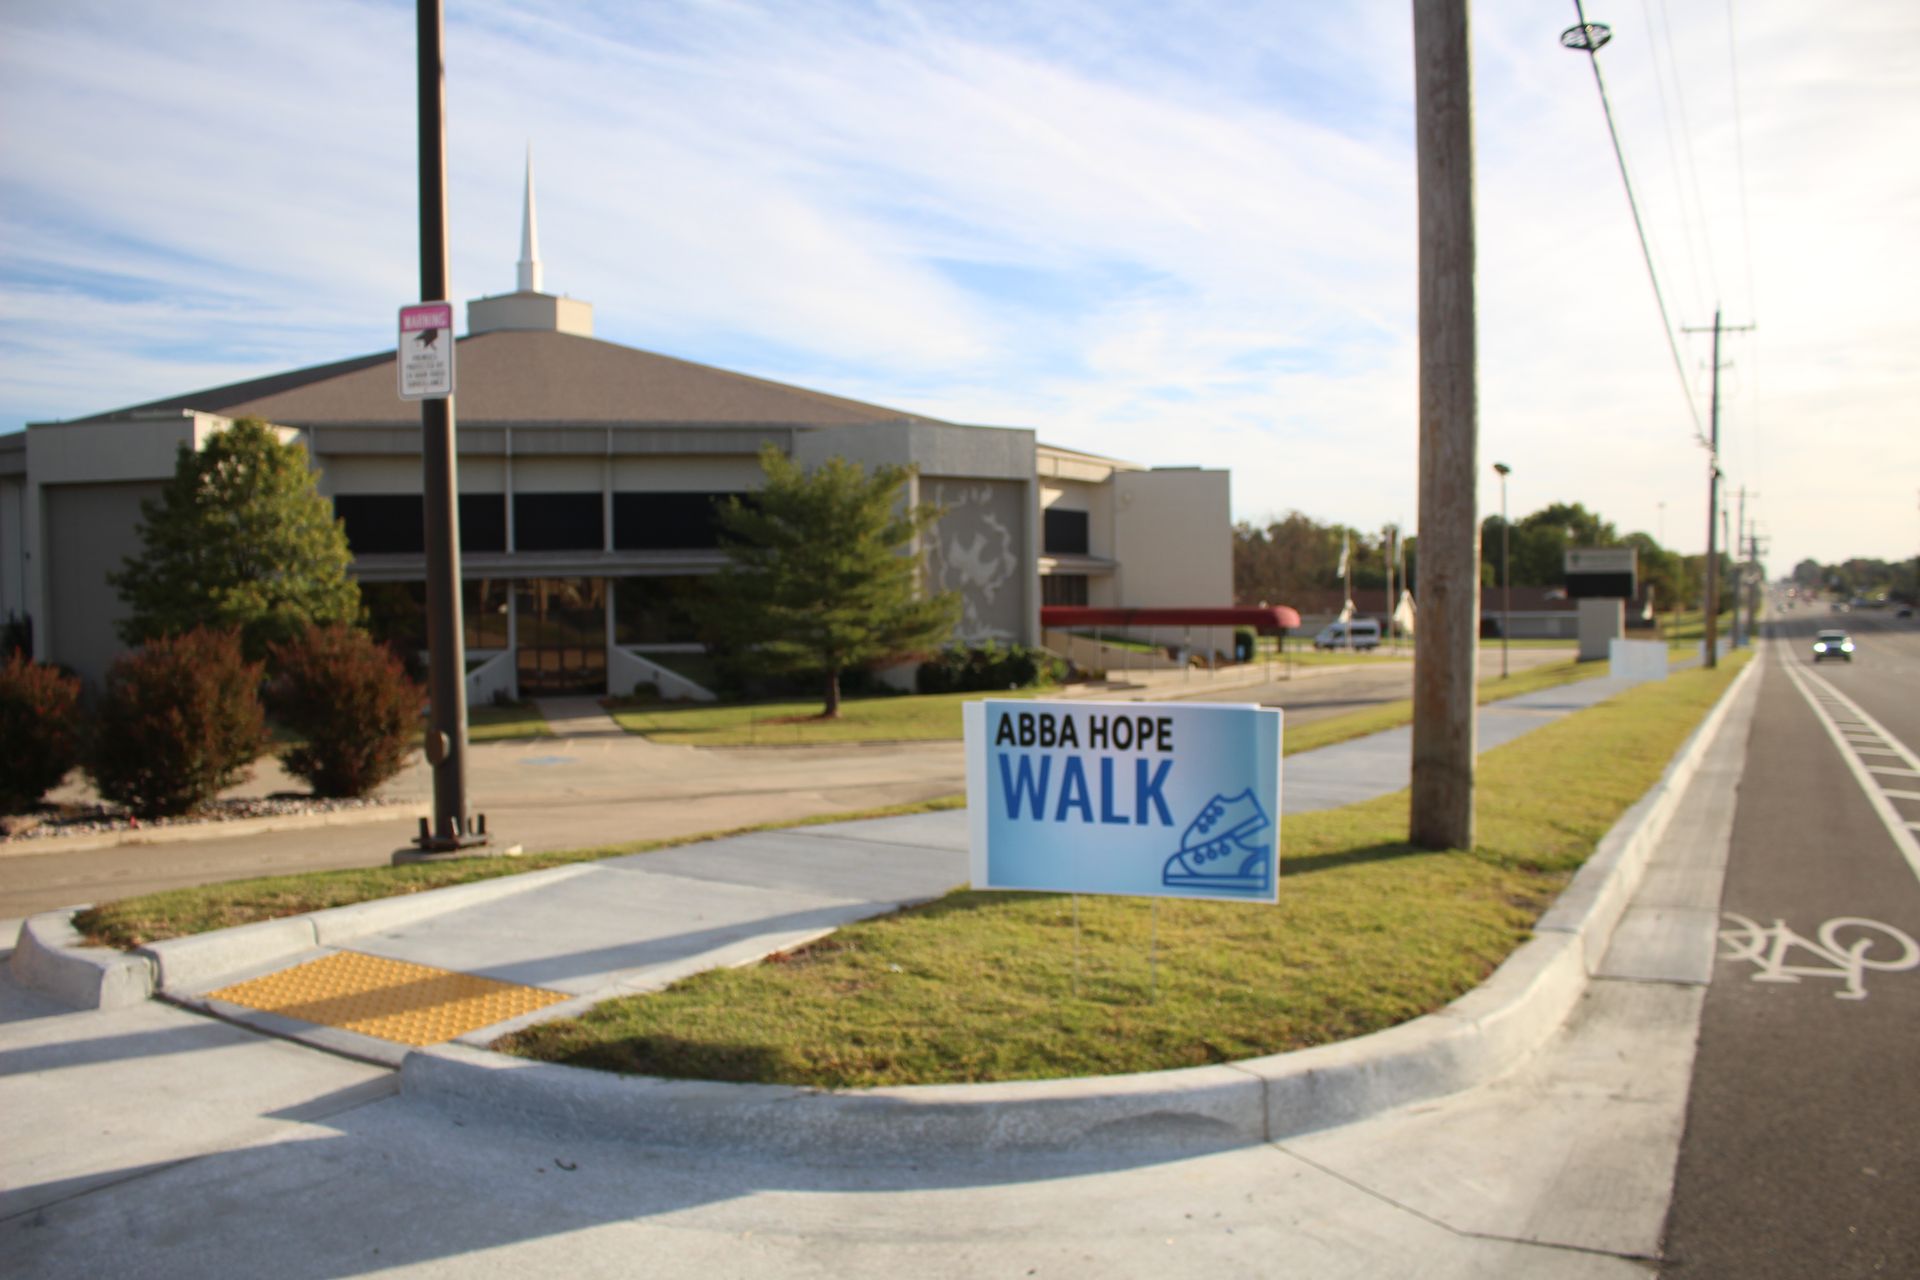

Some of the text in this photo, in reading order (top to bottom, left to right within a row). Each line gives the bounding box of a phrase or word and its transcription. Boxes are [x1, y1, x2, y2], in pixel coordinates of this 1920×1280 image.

[403, 312, 446, 328] WARNING
[996, 712, 1174, 751] ABBA HOPE
[998, 753, 1175, 826] WALK
